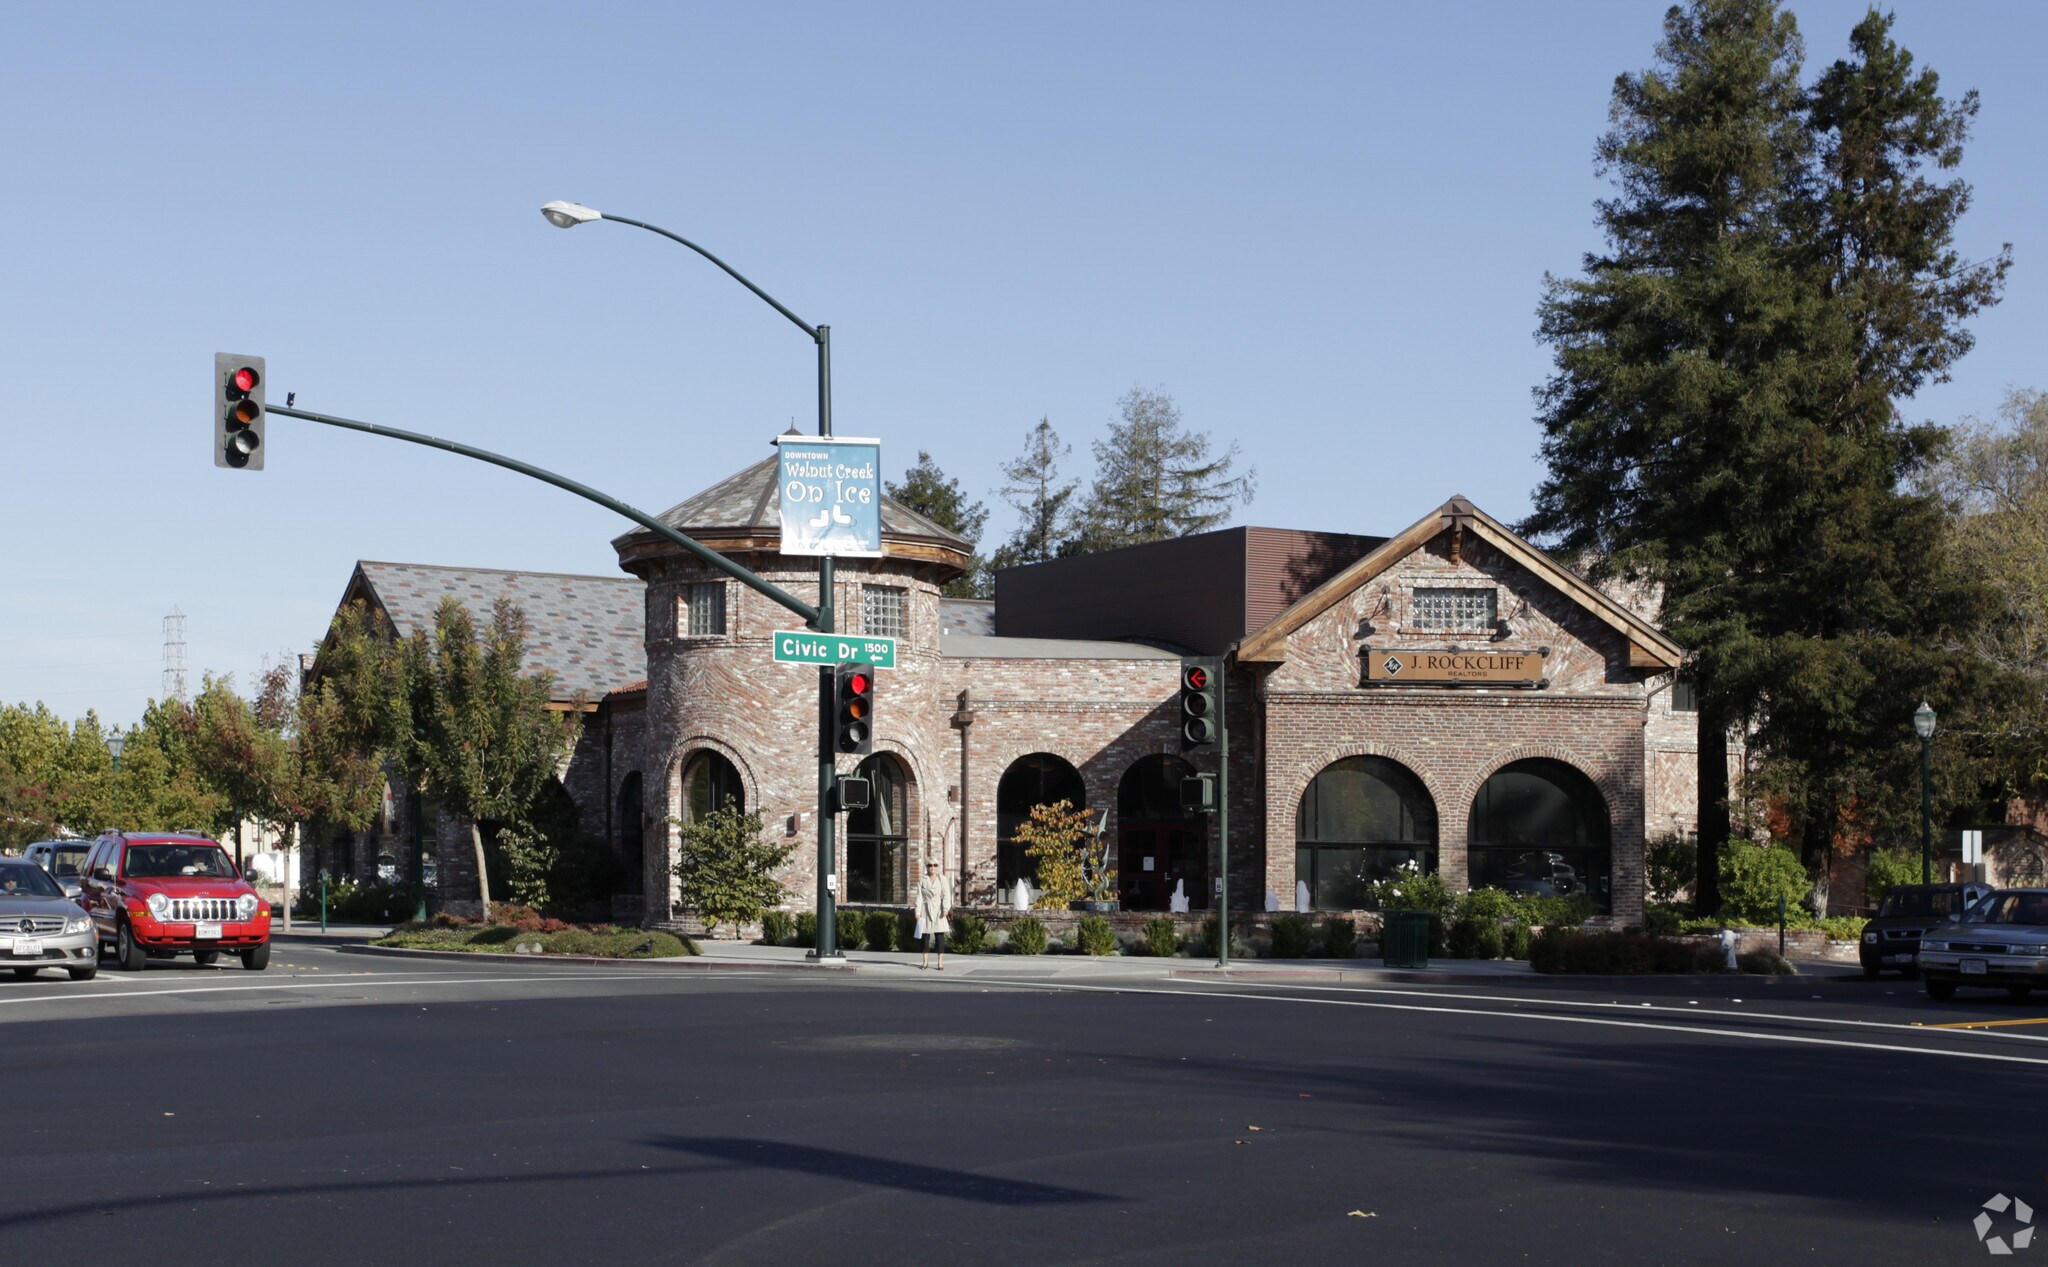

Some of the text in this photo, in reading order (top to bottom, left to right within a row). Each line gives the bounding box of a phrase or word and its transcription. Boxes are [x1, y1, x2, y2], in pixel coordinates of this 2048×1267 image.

[784, 451, 829, 460] DOWNTOWN
[784, 461, 874, 479] Walnut Creek
[785, 480, 871, 504] On Ice
[782, 639, 858, 660] Civic Dr
[864, 643, 889, 653] 1500
[1411, 655, 1525, 670] J. ROCKCLIFF
